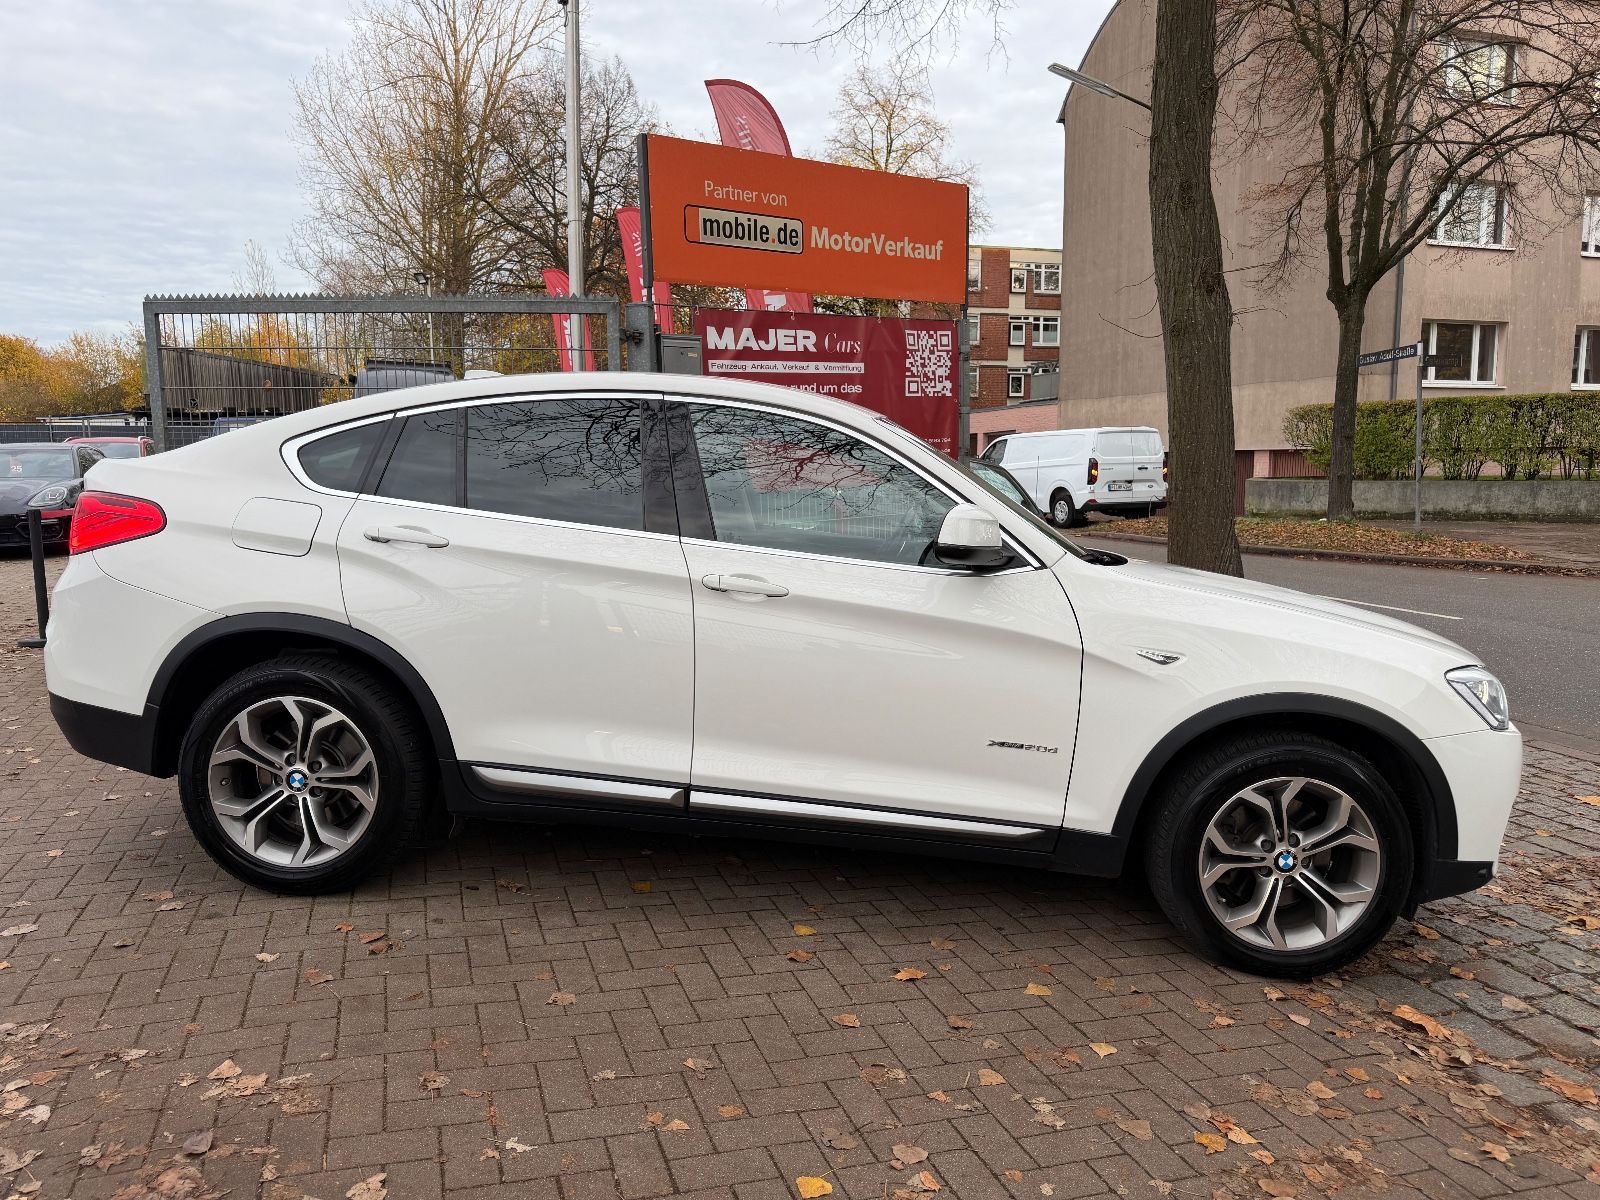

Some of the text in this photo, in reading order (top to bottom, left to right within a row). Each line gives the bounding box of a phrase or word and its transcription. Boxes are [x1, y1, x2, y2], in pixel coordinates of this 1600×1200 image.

[704, 180, 788, 207] Partner von
[702, 217, 944, 261] mobile.de MotorVerkauf
[706, 325, 861, 354] MAJER Cars
[781, 363, 810, 371] Verkauf
[819, 385, 838, 393] um
[840, 383, 863, 393] das
[10, 465, 23, 473] 25
